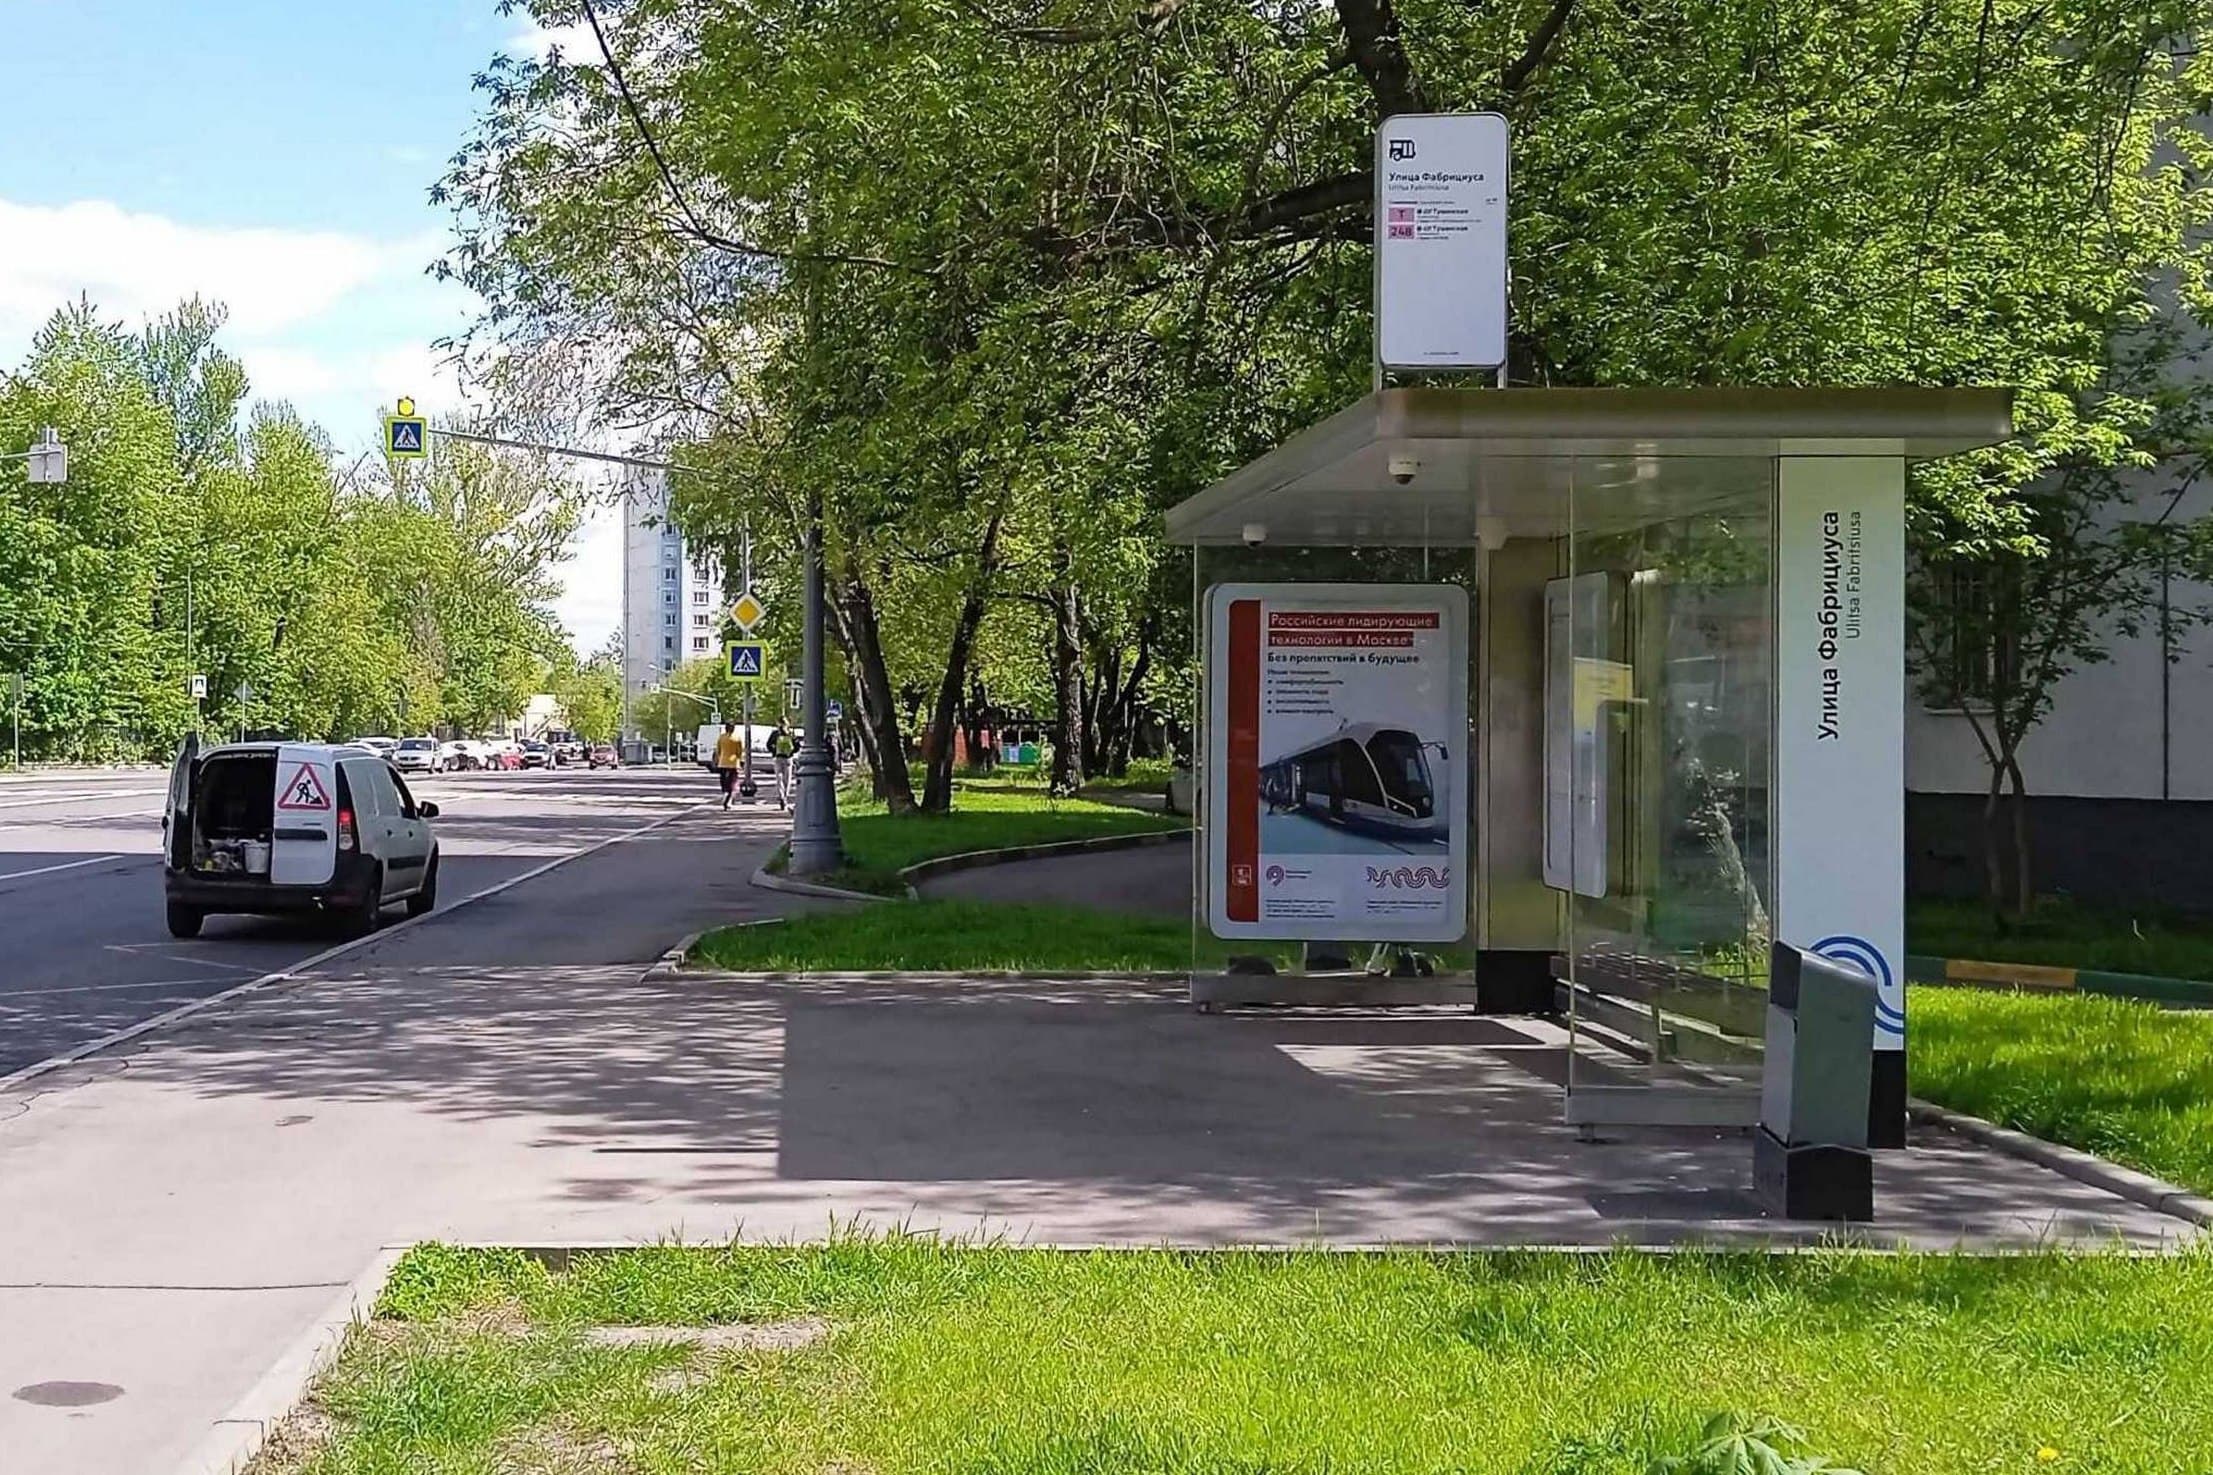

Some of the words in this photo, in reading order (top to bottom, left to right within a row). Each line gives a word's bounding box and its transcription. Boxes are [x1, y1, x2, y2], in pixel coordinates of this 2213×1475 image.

[1388, 172, 1420, 182] Улица
[1422, 172, 1484, 183] Фабрициуса
[1846, 511, 1861, 593] Fabritsiusa
[1818, 511, 1843, 660] Фабрициуса
[1270, 613, 1345, 627] Российские
[1348, 615, 1433, 628] лидирующие
[1846, 597, 1861, 639] Ulitsa
[1271, 635, 1343, 646] технологии
[1357, 634, 1408, 646] Москве
[1267, 652, 1287, 663] Без
[1367, 652, 1420, 665] будущее
[1818, 668, 1841, 740] Улица
